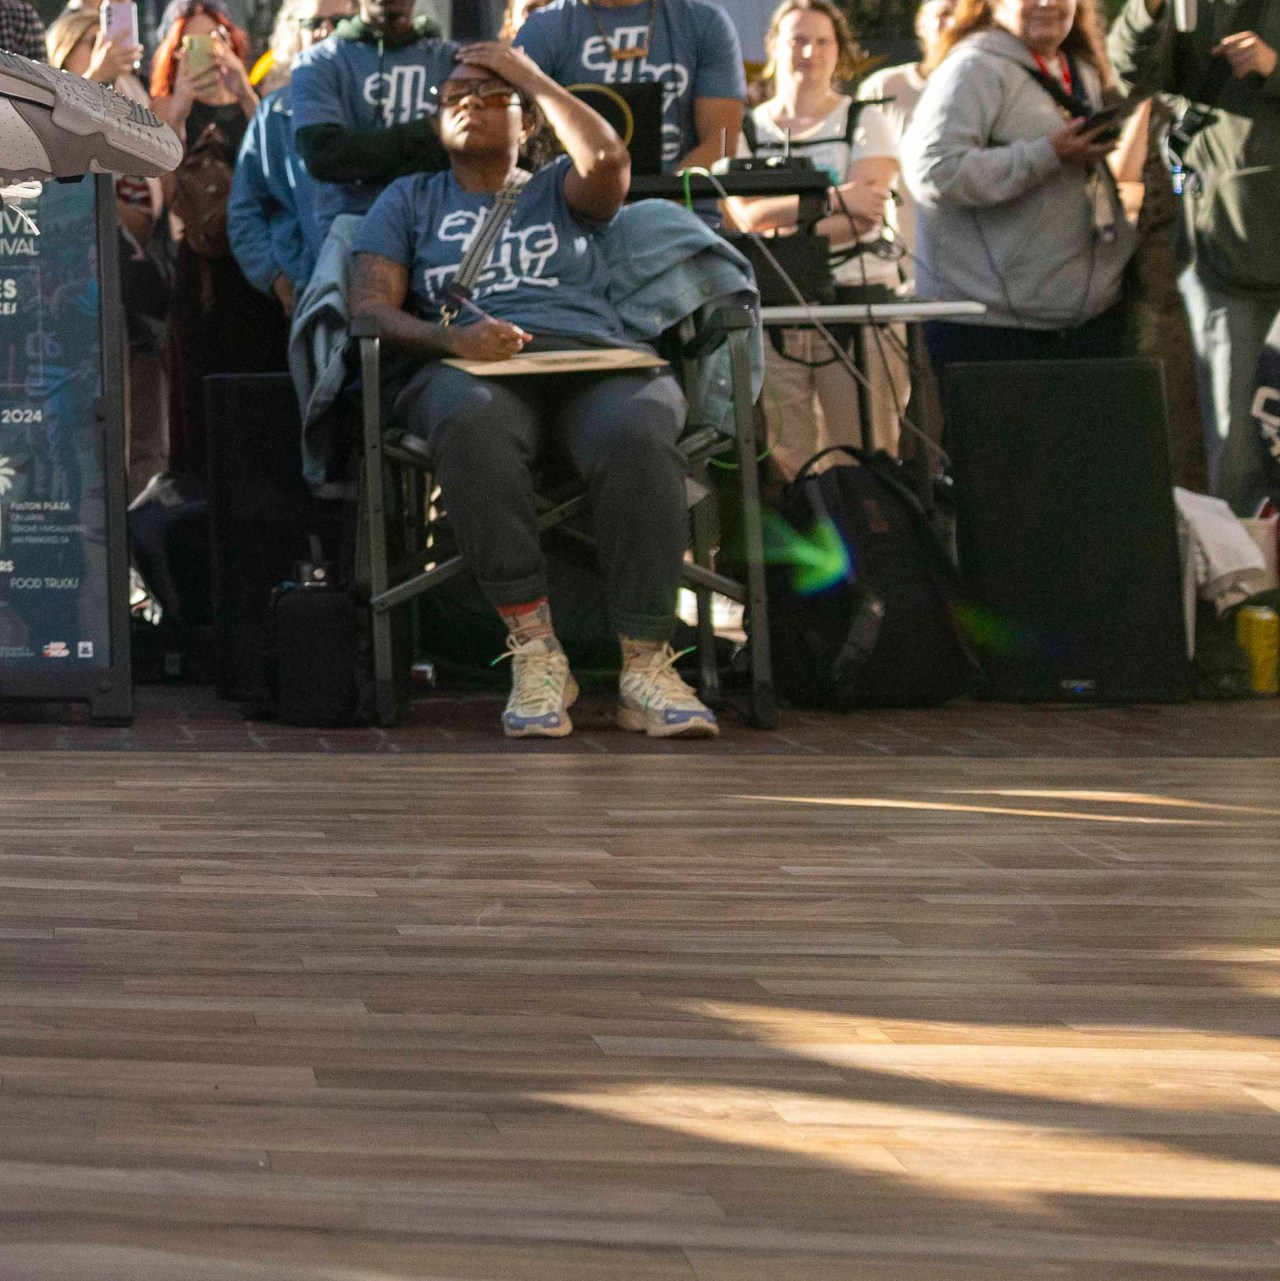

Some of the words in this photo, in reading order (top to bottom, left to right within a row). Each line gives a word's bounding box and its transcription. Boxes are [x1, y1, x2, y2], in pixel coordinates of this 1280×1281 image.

[1, 409, 43, 424] 2024
[43, 502, 71, 511] PLAZA
[10, 577, 42, 589] FOOD
